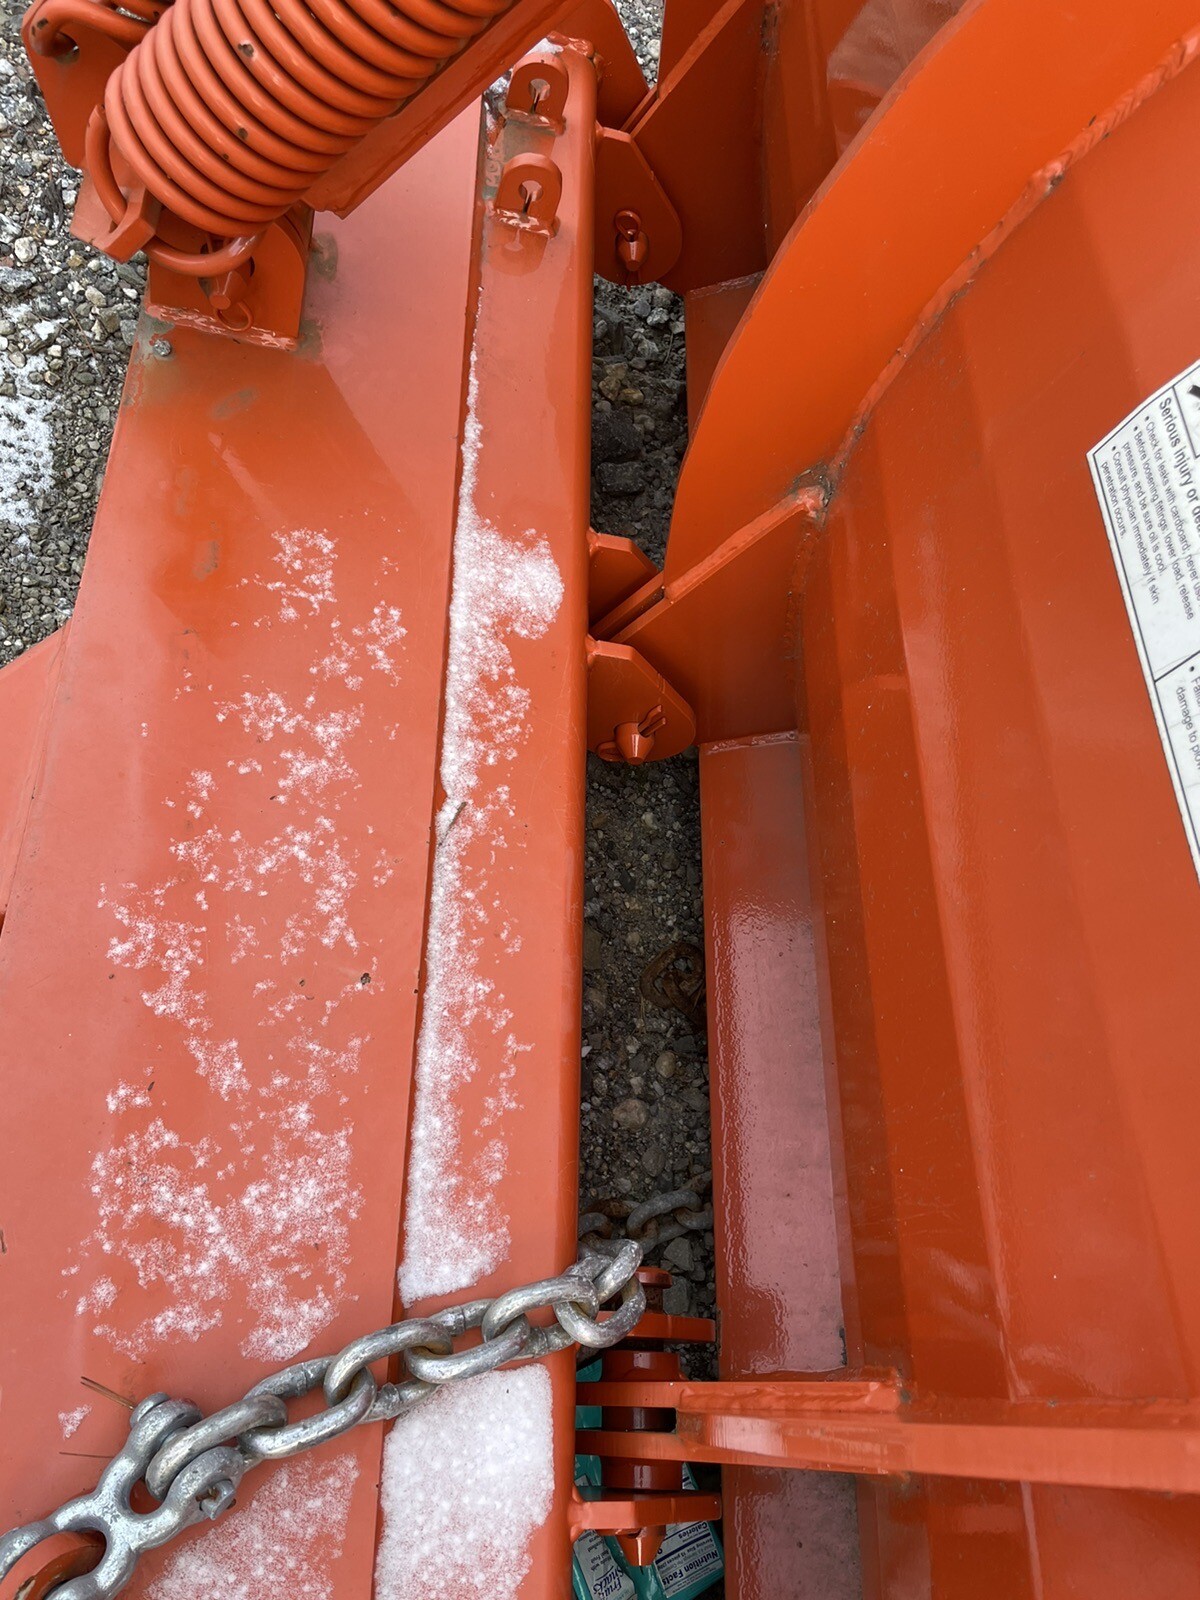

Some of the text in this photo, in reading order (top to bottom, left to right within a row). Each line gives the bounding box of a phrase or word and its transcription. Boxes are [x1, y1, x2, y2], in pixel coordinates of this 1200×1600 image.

[1145, 421, 1160, 450] Check
[1154, 448, 1163, 461] for
[1159, 397, 1199, 503] Serious injury or
[1101, 461, 1119, 508] penetration
[1157, 461, 1170, 487] leaks
[1134, 480, 1146, 499] and
[1164, 485, 1177, 506] with
[1139, 496, 1148, 511] be
[1112, 451, 1160, 605] Consult physician immediately if skin
[1133, 430, 1147, 461] Before
[1142, 458, 1159, 504] loosening
[1164, 531, 1177, 559] lower
[1178, 583, 1194, 620] release
[1142, 510, 1153, 531] sure
[1148, 531, 1159, 544] oil
[1152, 541, 1160, 553] is
[1185, 554, 1199, 581] never
[1176, 686, 1193, 731] damage
[1188, 729, 1198, 744] to
[678, 1521, 708, 1539] Calories
[683, 1549, 719, 1573] Nutrition
[593, 1566, 624, 1594] Snacks
[662, 1569, 684, 1586] Facts
